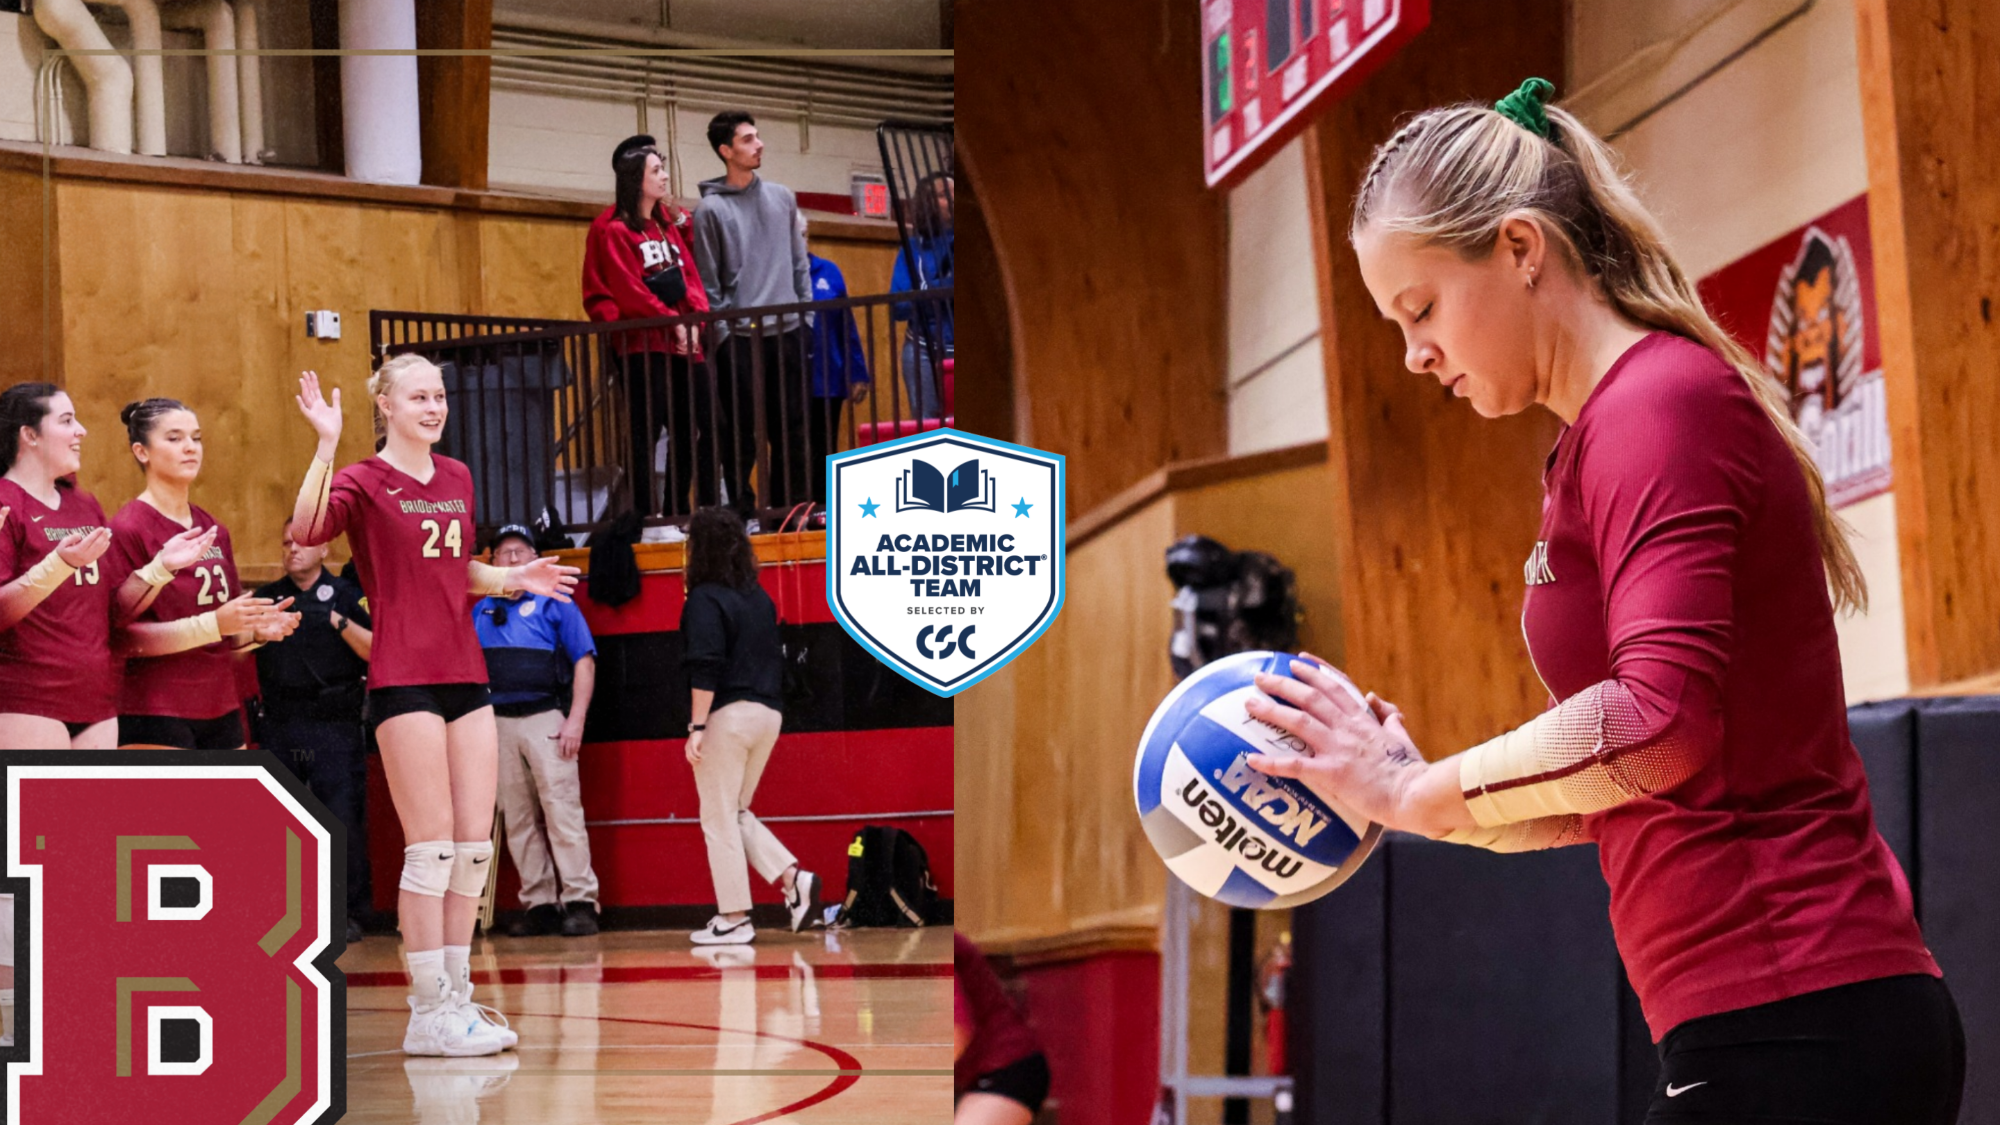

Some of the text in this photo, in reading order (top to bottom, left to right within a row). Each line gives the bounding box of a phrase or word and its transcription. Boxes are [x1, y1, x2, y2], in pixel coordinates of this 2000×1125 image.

[399, 499, 467, 513] BRIDGEWATER
[420, 518, 462, 558] 24
[194, 564, 230, 606] 23
[1220, 753, 1328, 848] NCAA
[1182, 778, 1304, 879] molten
